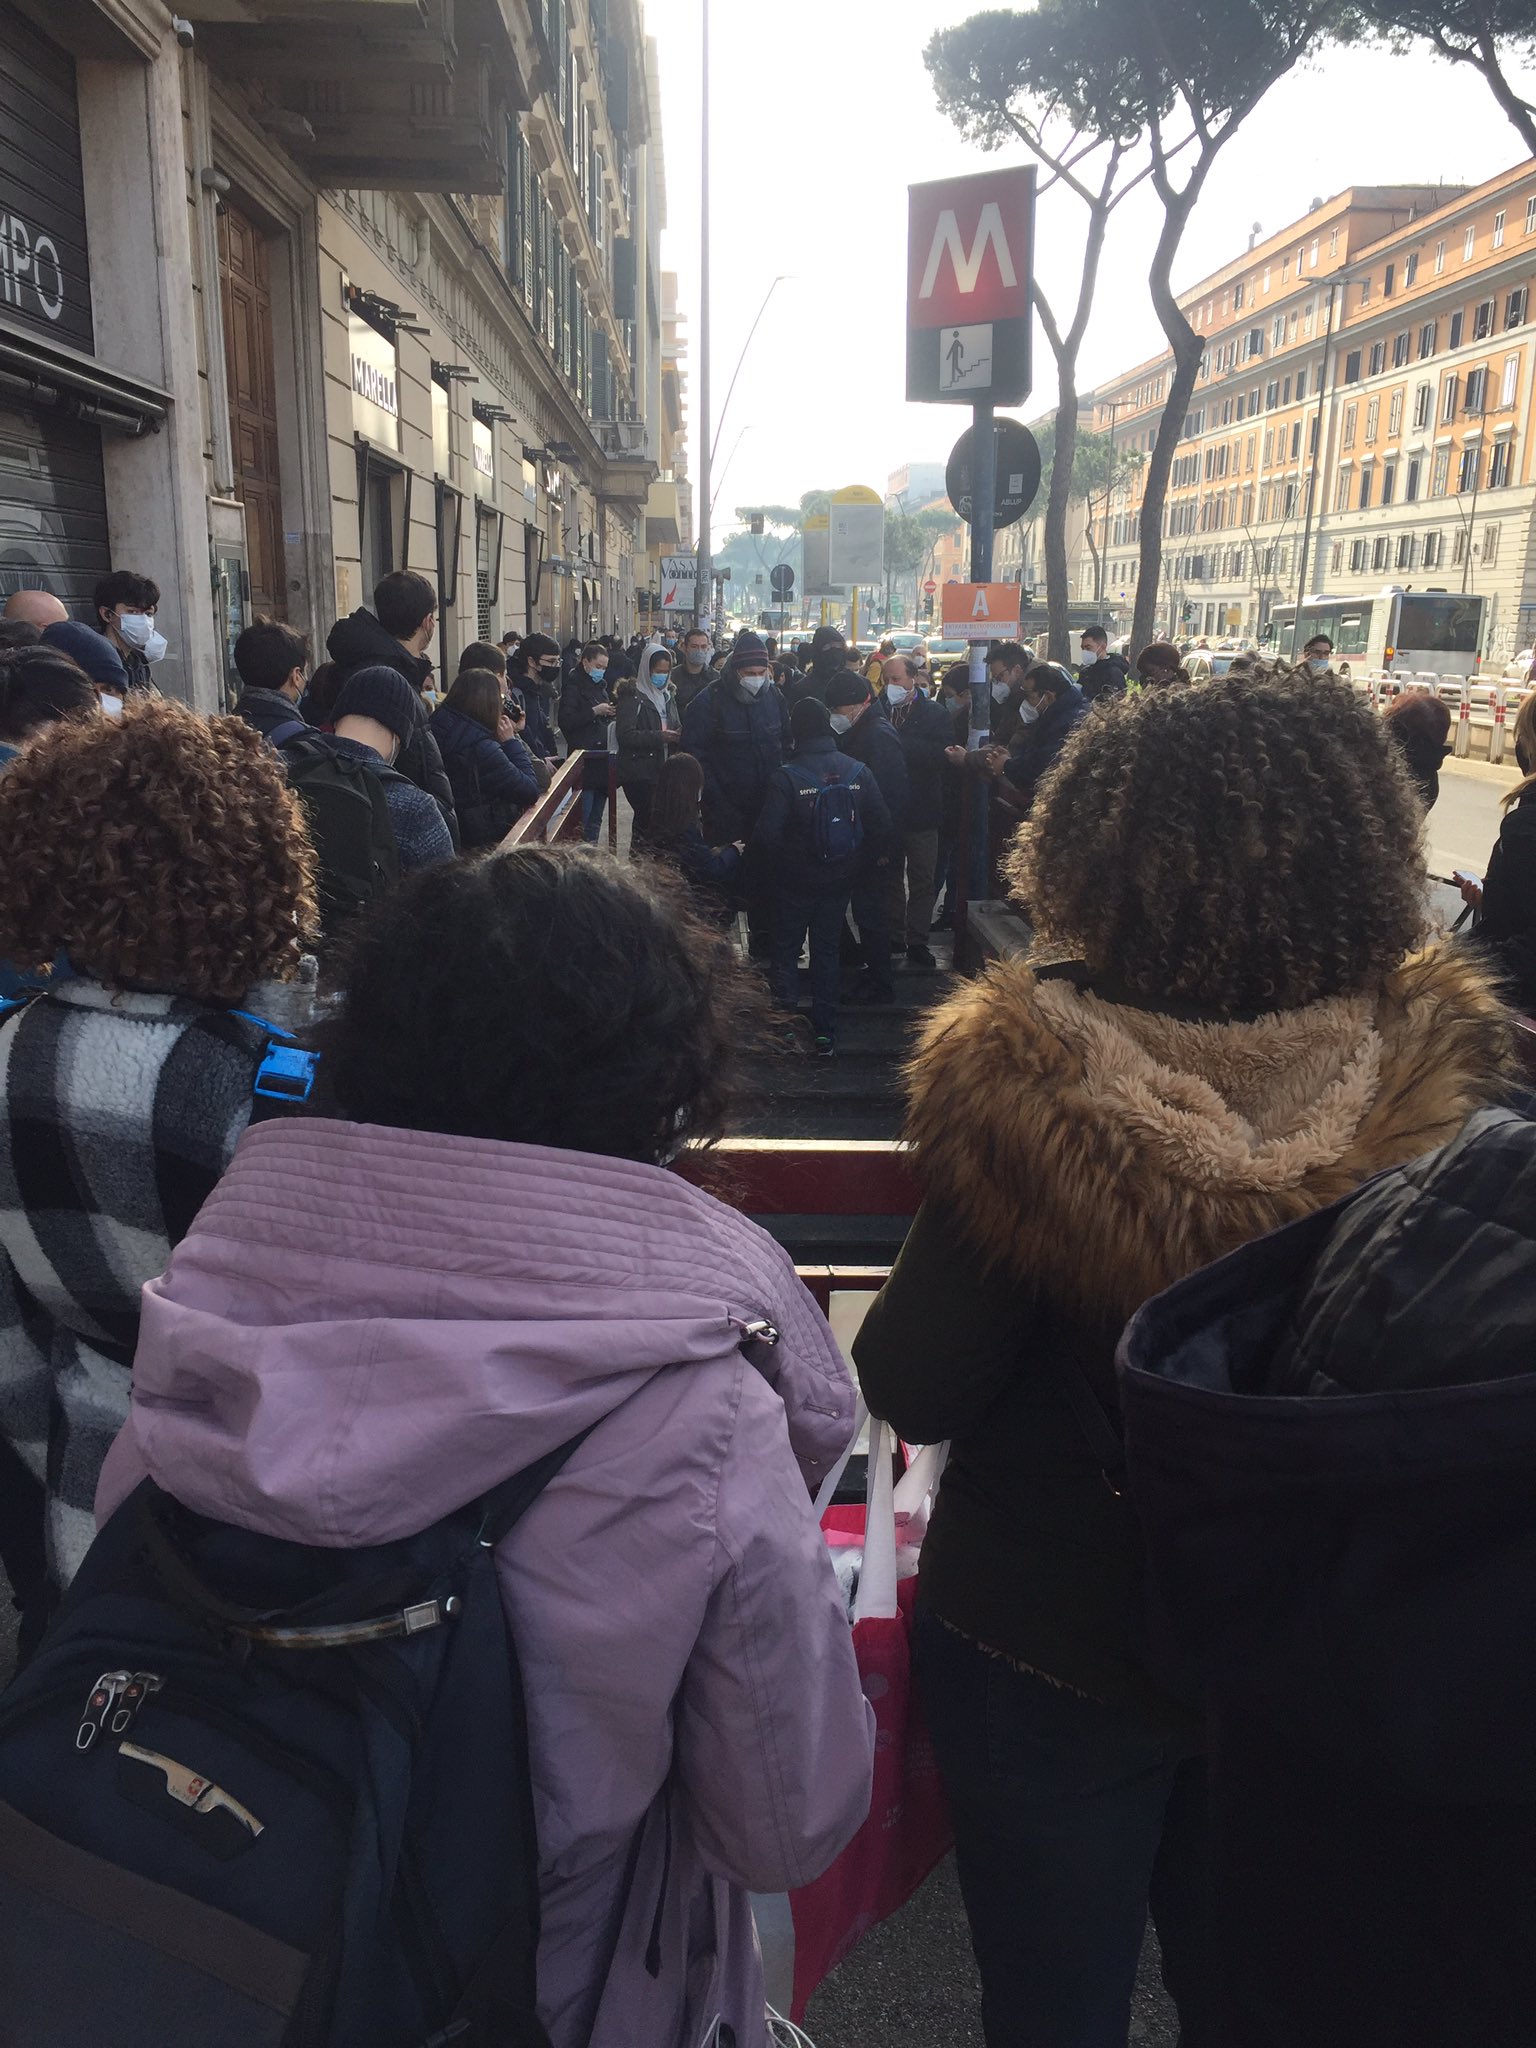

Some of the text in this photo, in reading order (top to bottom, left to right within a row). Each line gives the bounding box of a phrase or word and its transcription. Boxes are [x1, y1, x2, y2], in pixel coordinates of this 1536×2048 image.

[918, 202, 1018, 299] M
[351, 353, 399, 418] MARELLA
[971, 590, 990, 617] A
[848, 783, 860, 791] orio
